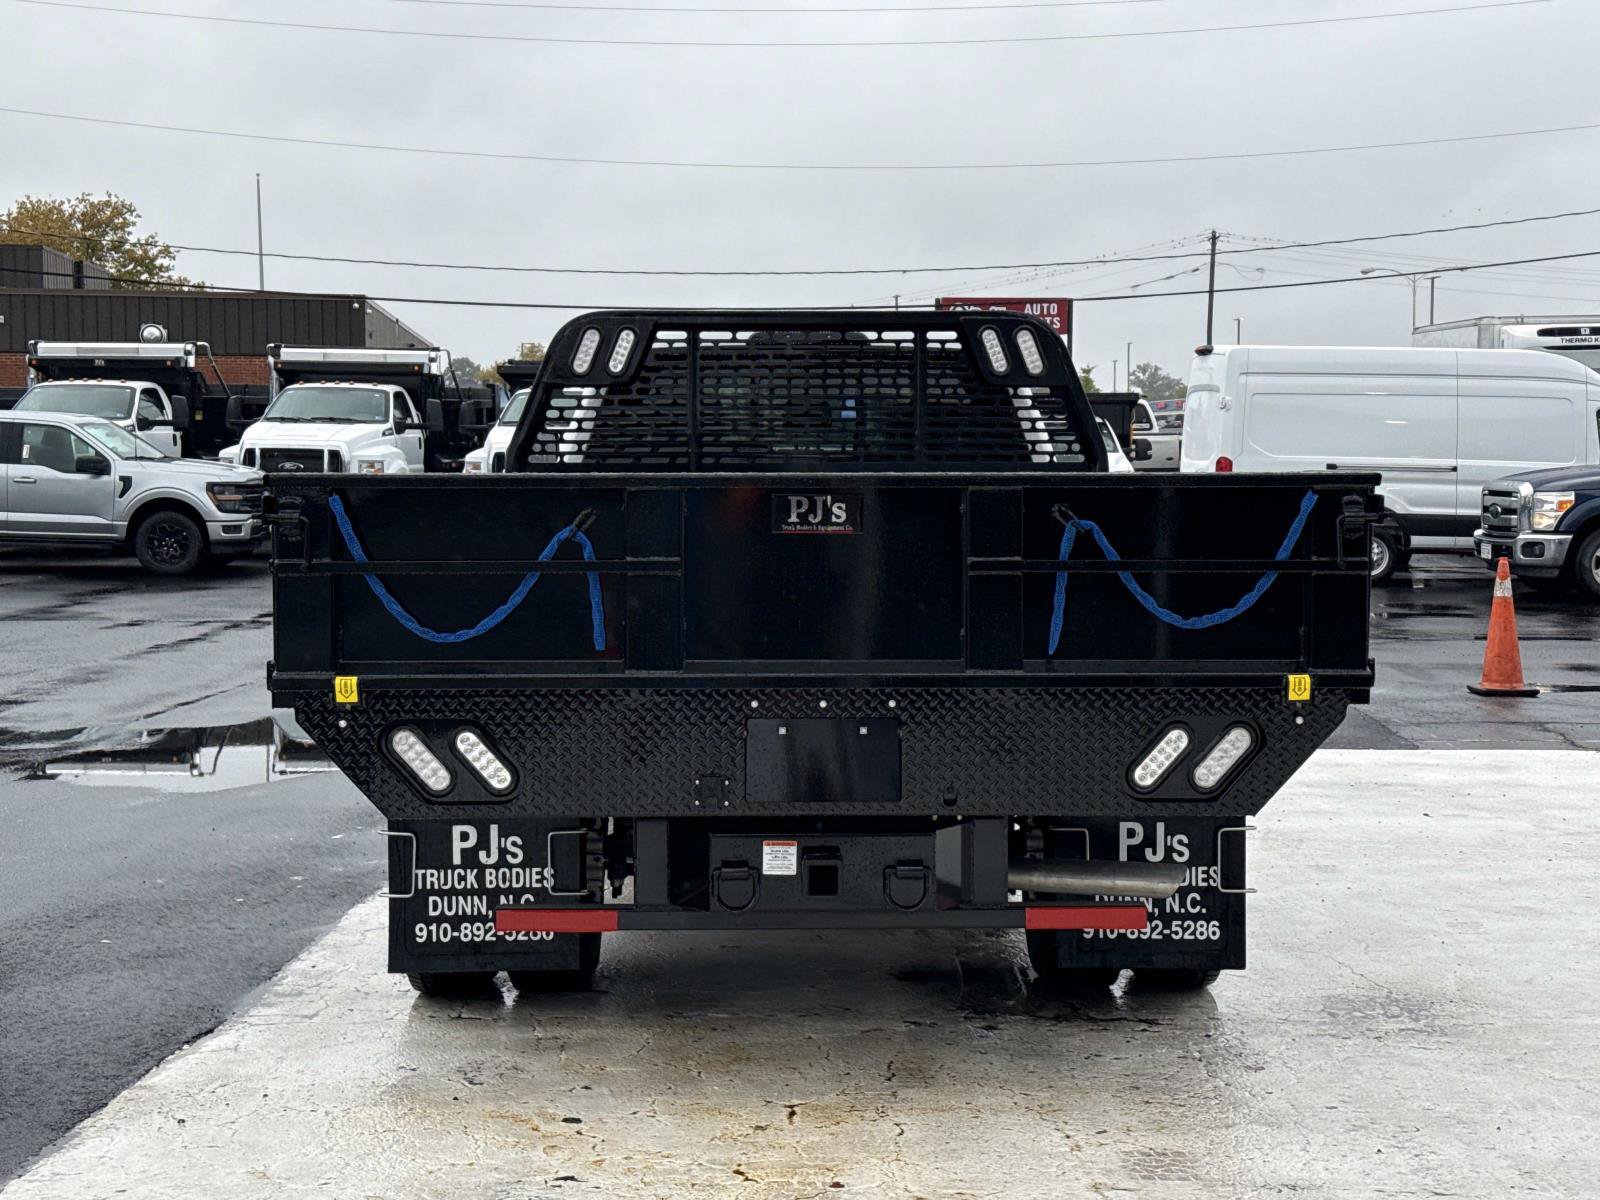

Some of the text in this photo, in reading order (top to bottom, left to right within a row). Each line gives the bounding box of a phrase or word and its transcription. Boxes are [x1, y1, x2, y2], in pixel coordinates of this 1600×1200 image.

[1024, 303, 1058, 316] AUTO
[787, 495, 847, 523] PJ's
[452, 824, 524, 865] PJ's
[1119, 821, 1190, 863] PJ's
[415, 867, 555, 890] TRUCK BODIES
[428, 895, 493, 919] DUNN,
[1166, 892, 1207, 914] N.C.
